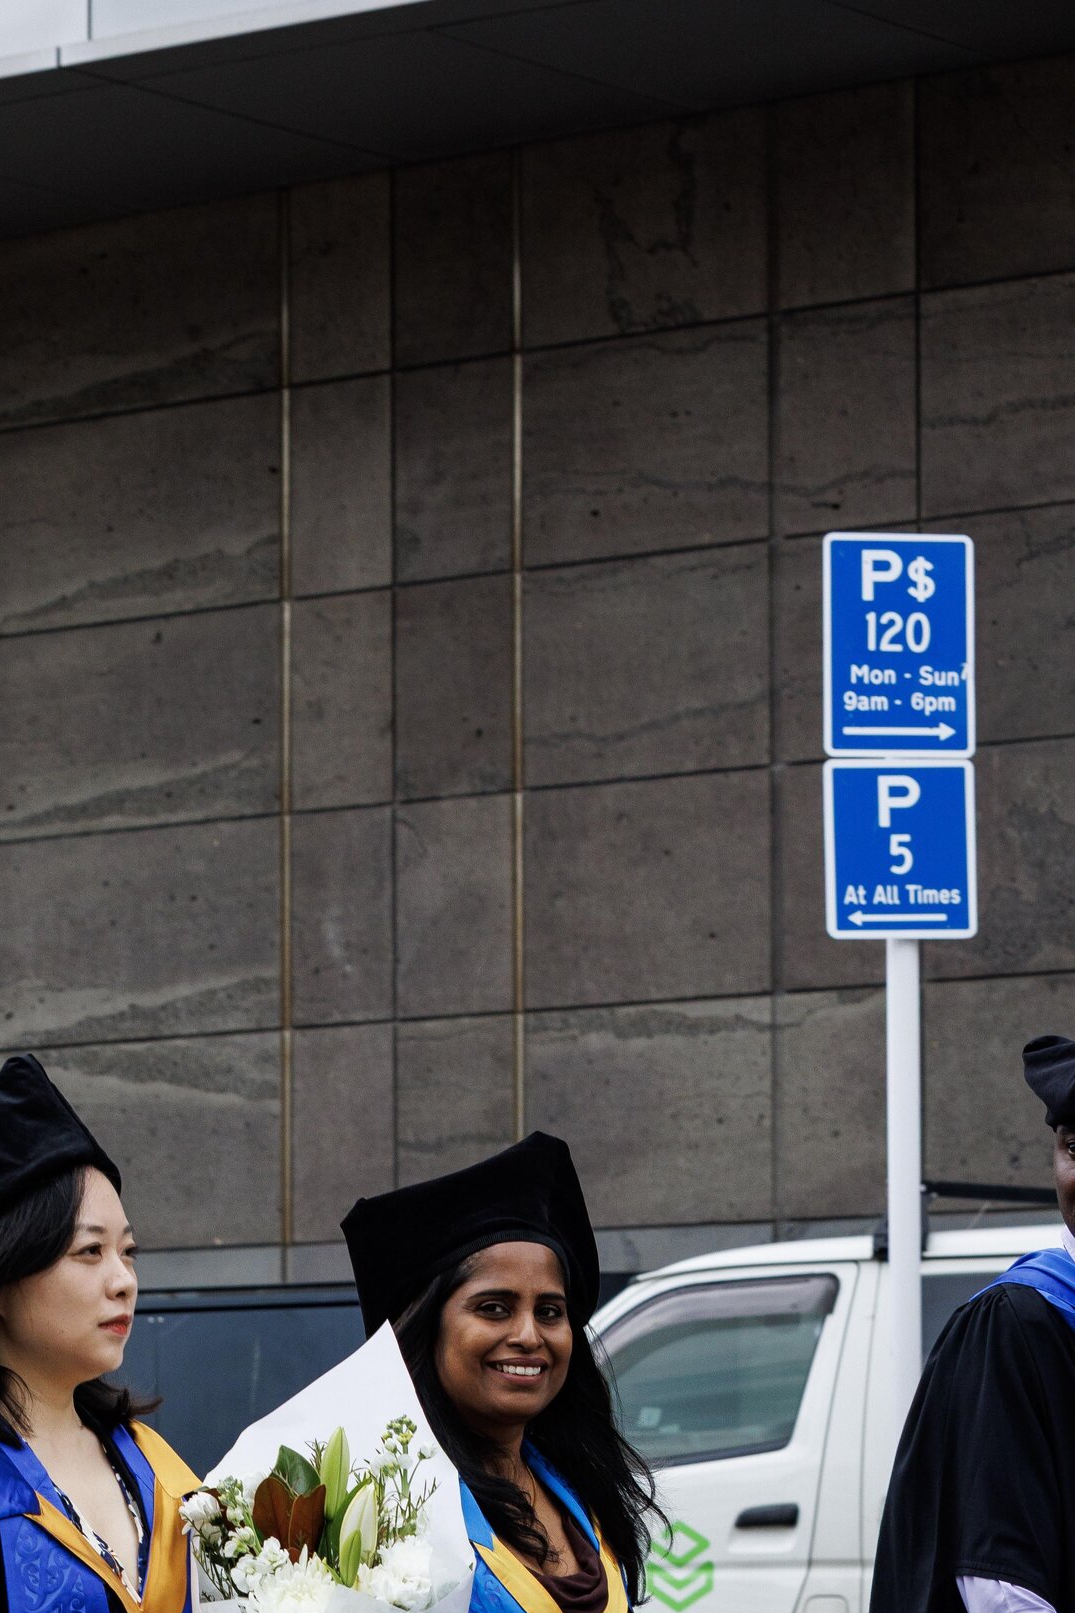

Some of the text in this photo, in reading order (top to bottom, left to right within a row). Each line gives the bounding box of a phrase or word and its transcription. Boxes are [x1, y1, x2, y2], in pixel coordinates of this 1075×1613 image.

[865, 611, 931, 653] 120
[850, 663, 897, 685] Mon
[918, 665, 960, 687] Sun
[843, 690, 889, 712] 9am
[910, 692, 957, 717] 6pm
[877, 774, 921, 828] P
[889, 833, 914, 875] 5
[843, 883, 962, 906] At All Times
